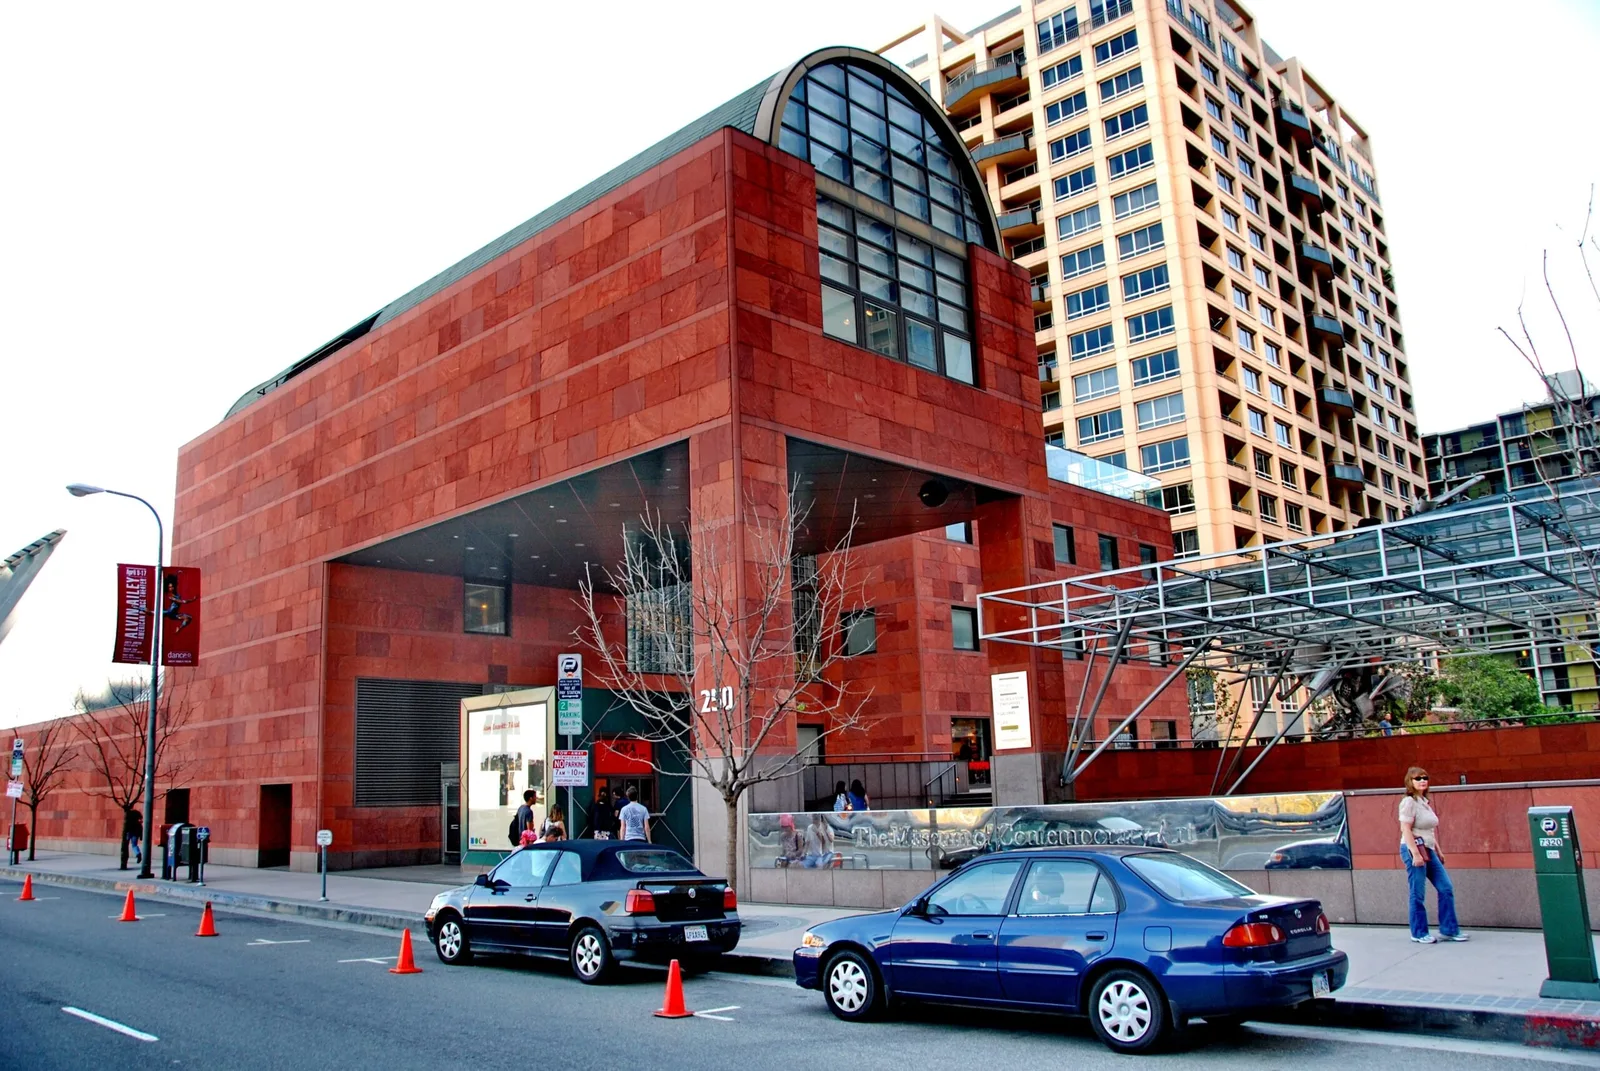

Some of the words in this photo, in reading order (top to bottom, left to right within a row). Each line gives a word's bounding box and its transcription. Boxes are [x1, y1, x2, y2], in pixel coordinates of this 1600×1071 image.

[126, 577, 140, 604] AILEY
[125, 608, 139, 639] ALVIN
[851, 826, 888, 848] The
